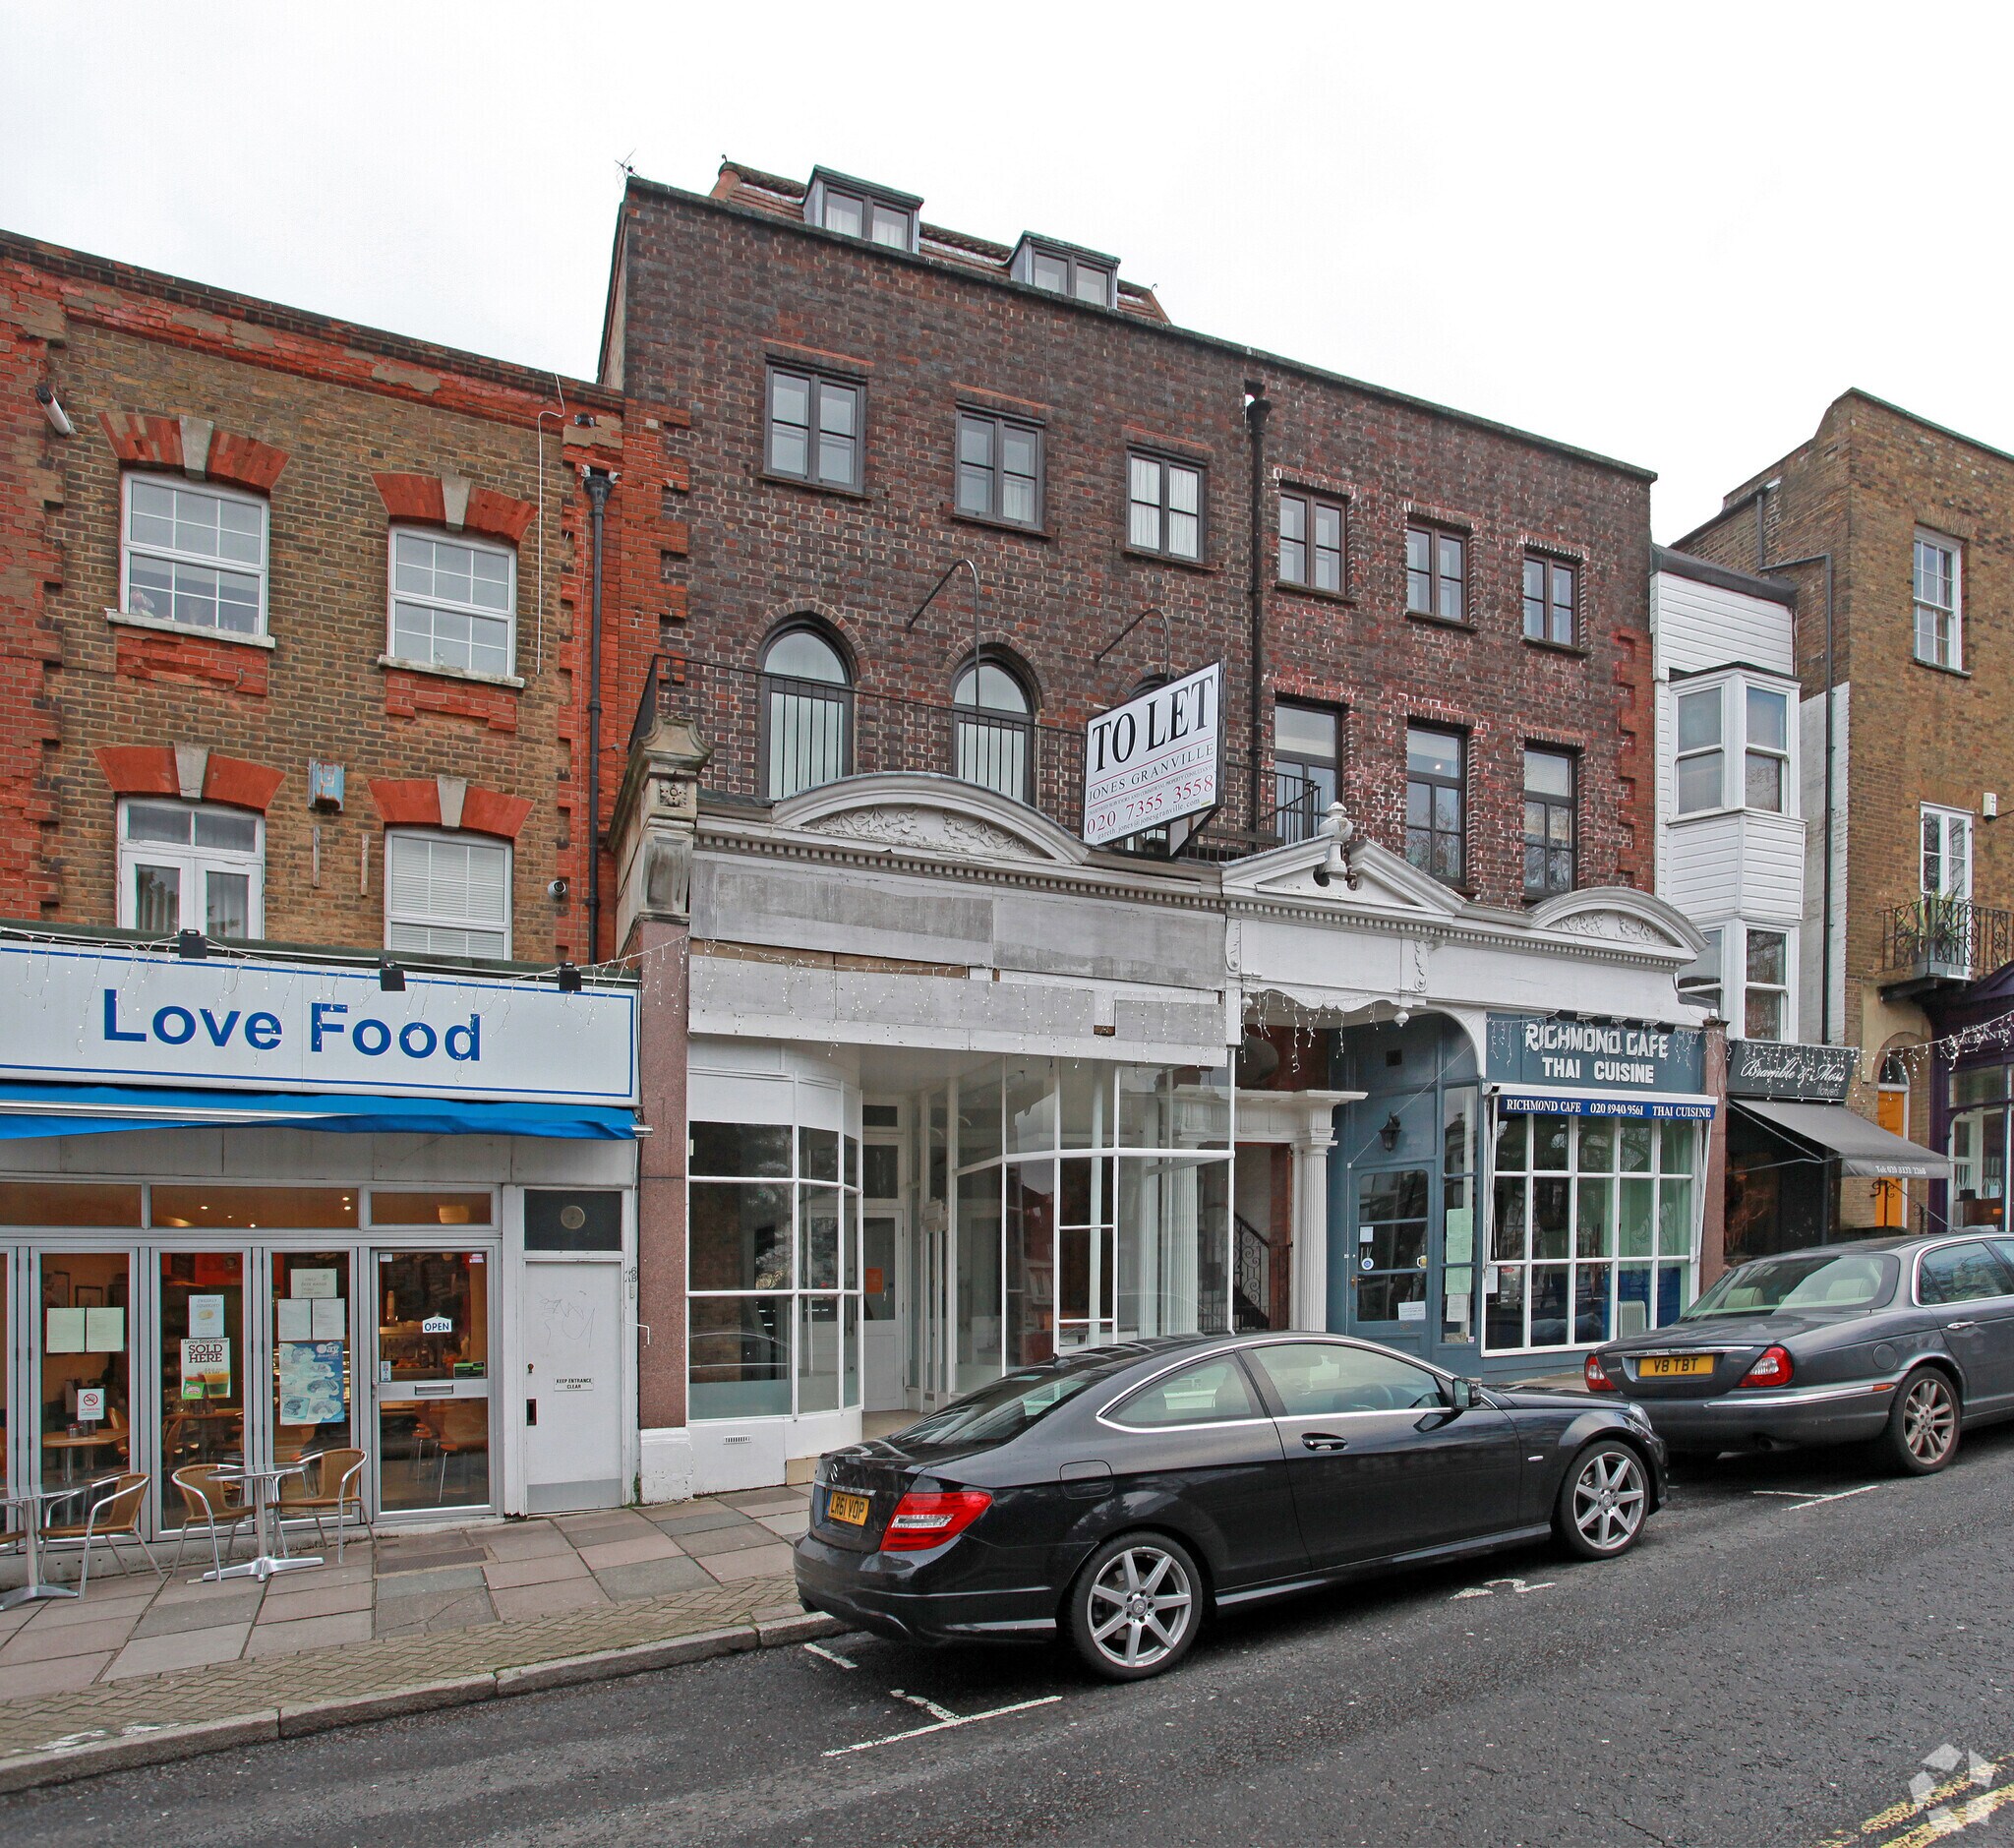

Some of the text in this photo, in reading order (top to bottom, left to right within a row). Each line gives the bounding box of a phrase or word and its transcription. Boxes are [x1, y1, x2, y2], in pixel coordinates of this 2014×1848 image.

[1092, 675, 1214, 774] TO LET
[1088, 744, 1214, 803] JONES GRANVILLE
[1087, 775, 1214, 835] 020 7355 3558
[103, 988, 481, 1062] Love Food
[1525, 1023, 1669, 1058] RICHMOND CAFE
[1542, 1057, 1654, 1084] THAI CUISINE
[1741, 1056, 1798, 1080] Bramble
[1507, 1099, 1711, 1118] RICHMOND CAFE 020 8940 9561 THAI CUISINE
[424, 1322, 449, 1332] OPEN
[188, 1343, 223, 1354] SOLD
[188, 1353, 222, 1363] HERE
[1654, 1358, 1698, 1373] V8 TBT
